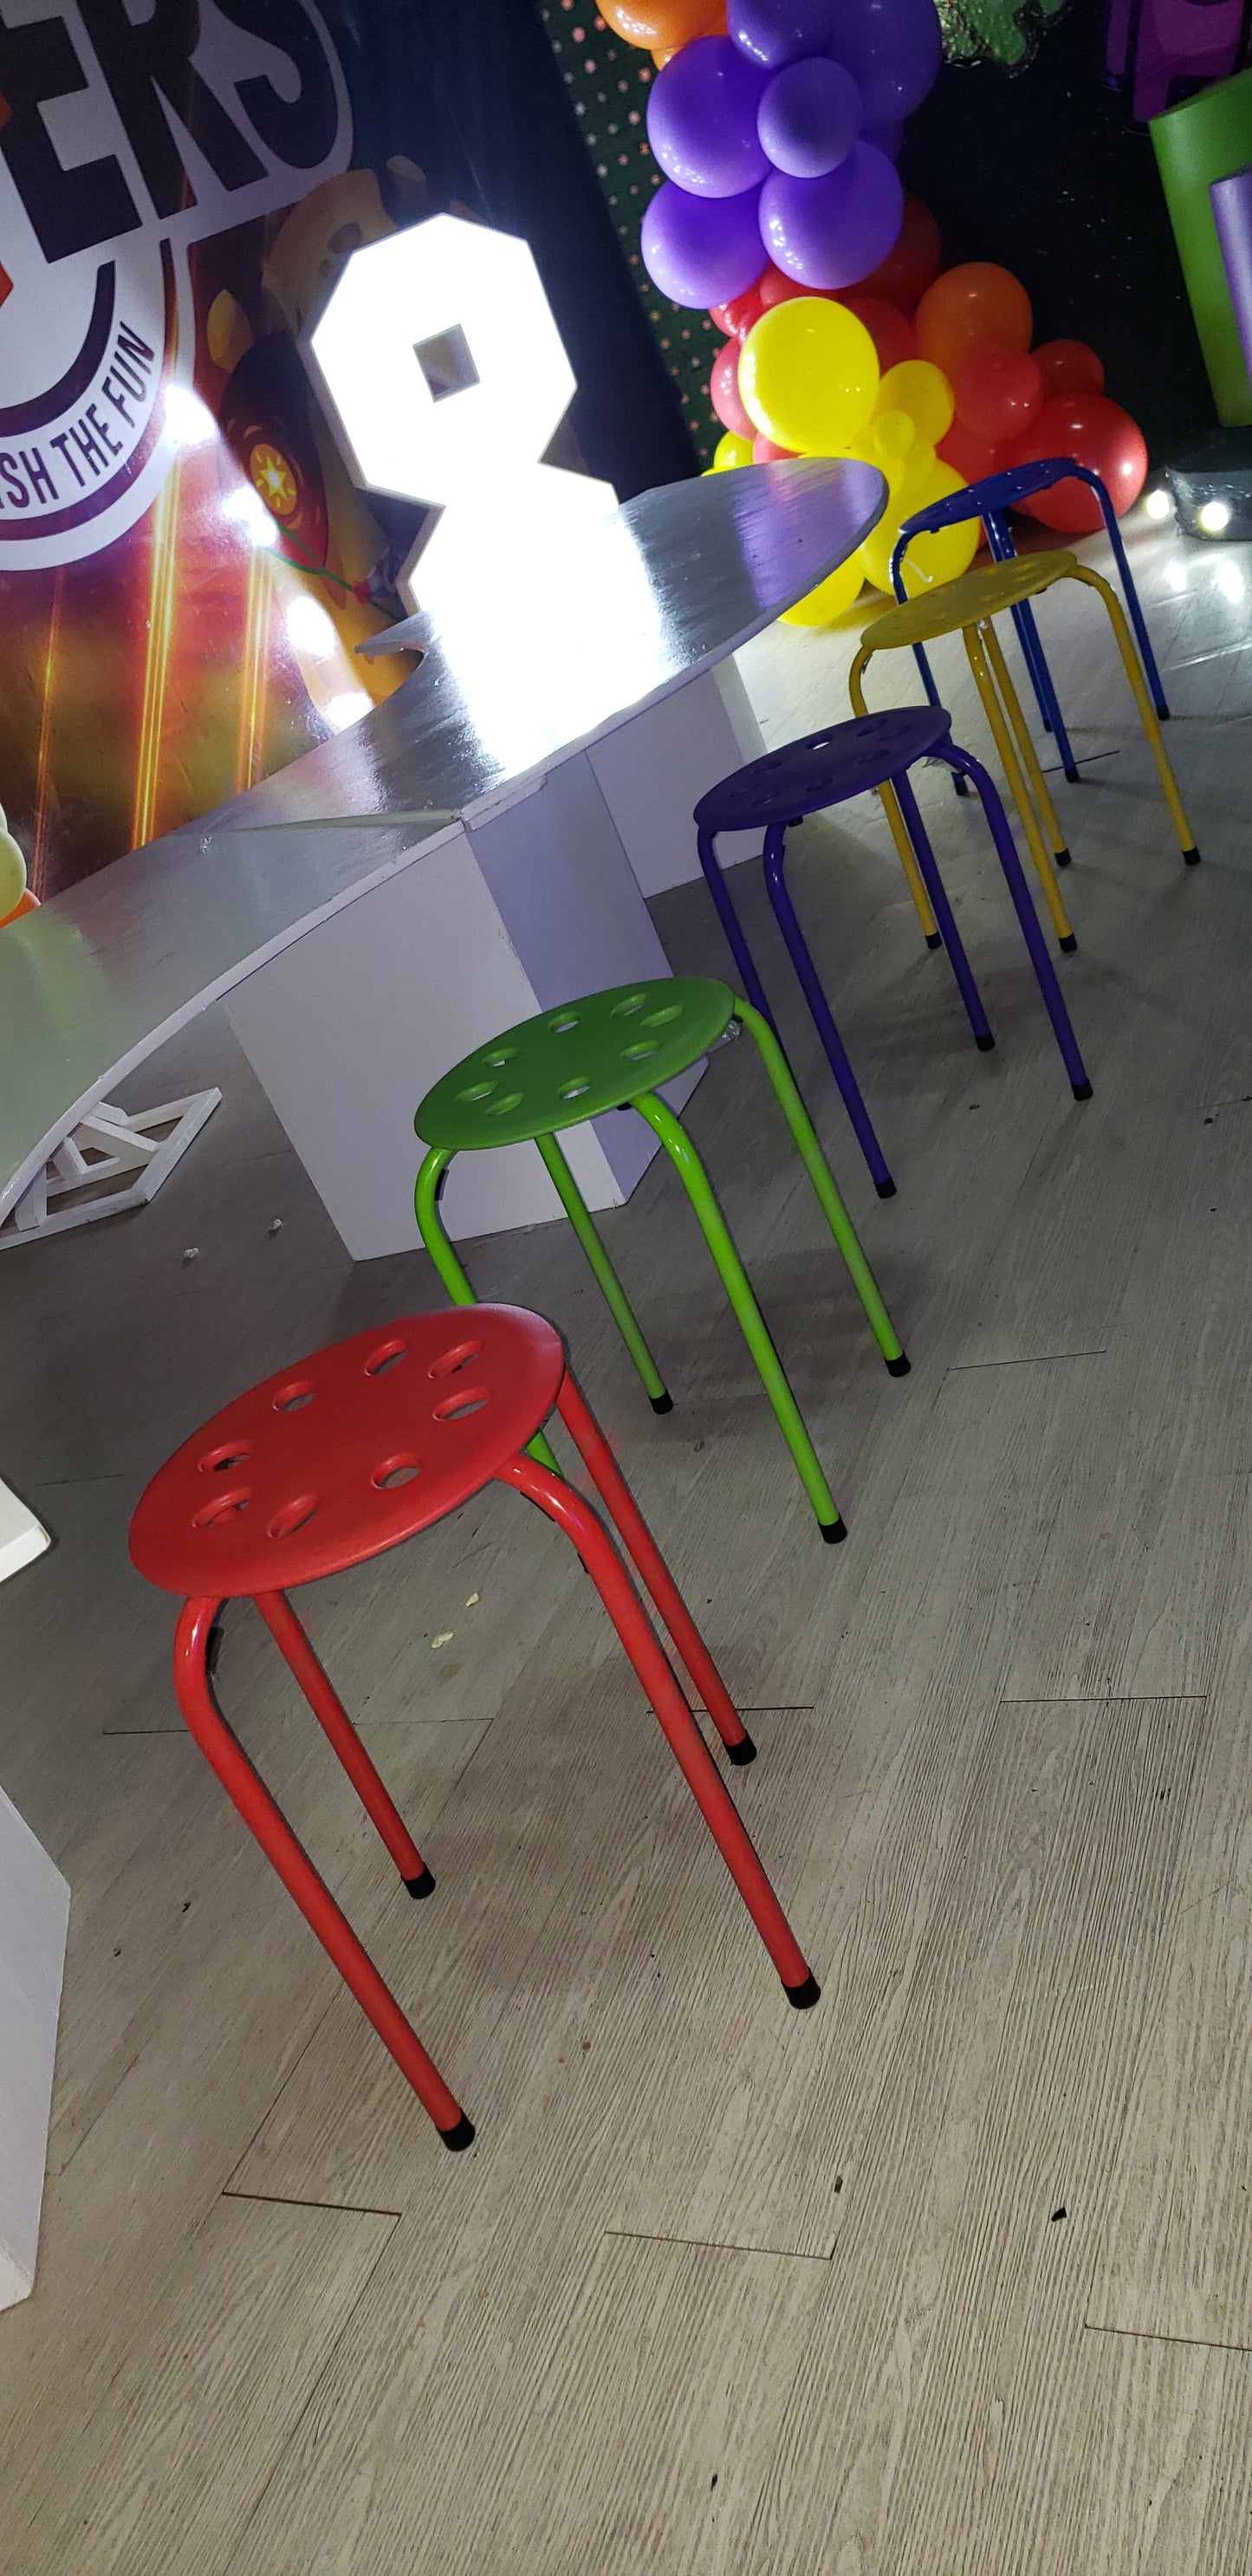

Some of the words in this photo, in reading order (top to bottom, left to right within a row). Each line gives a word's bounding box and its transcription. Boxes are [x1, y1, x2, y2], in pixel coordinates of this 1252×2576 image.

[0, 447, 59, 509] SH
[49, 403, 124, 487] THE
[101, 321, 155, 428] FUN
